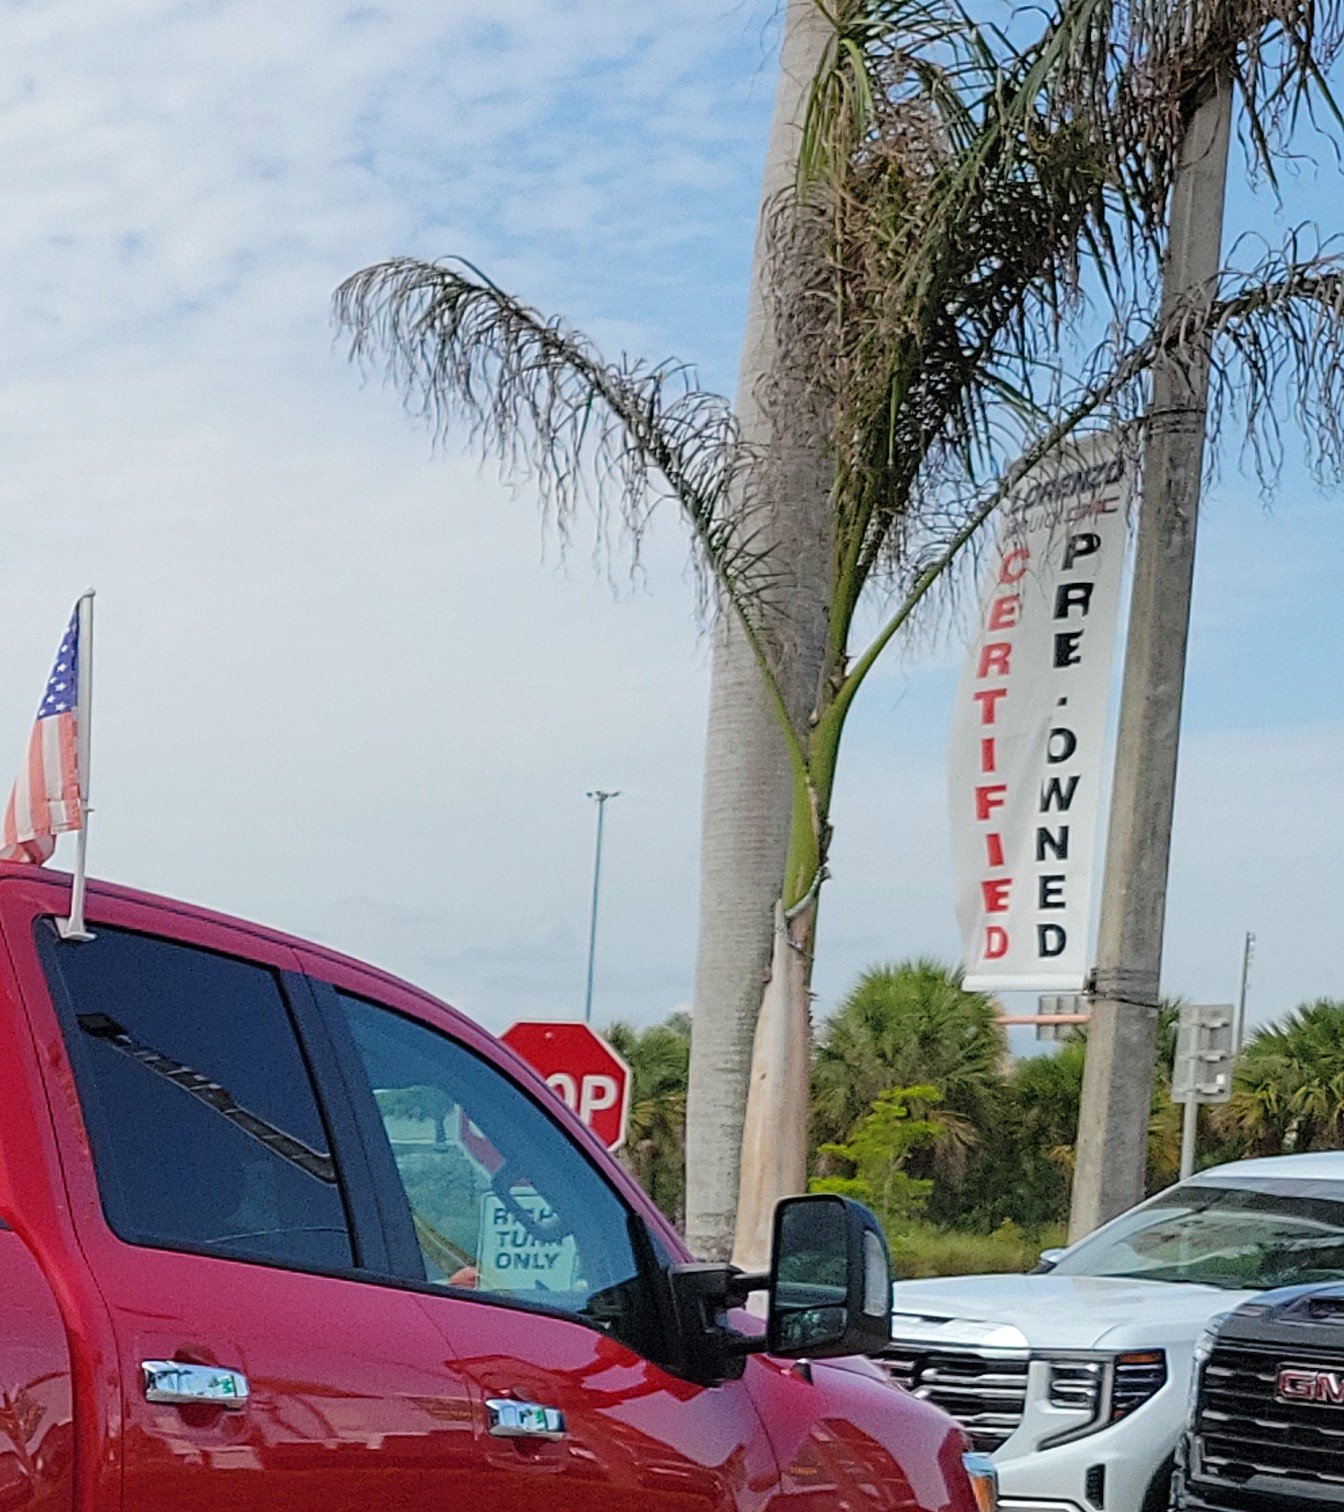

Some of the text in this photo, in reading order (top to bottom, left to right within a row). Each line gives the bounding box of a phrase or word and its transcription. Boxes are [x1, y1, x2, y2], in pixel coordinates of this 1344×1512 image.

[973, 548, 1030, 960] CERTIFIED
[545, 1072, 618, 1126] OP
[496, 1253, 559, 1269] ONLY
[1279, 1369, 1344, 1403] GM
